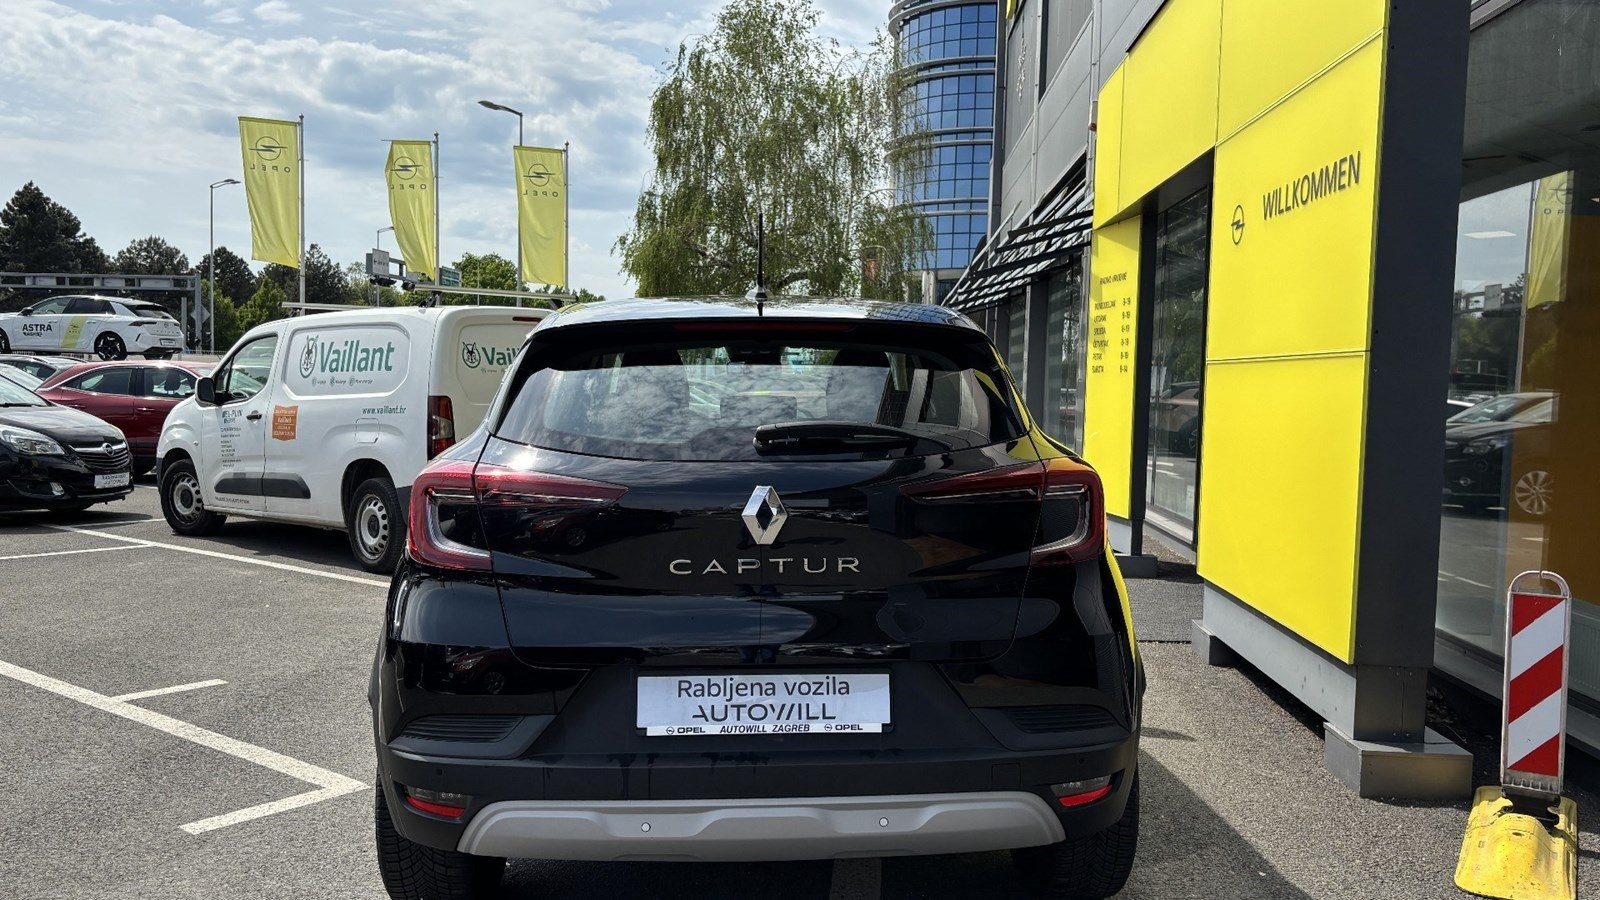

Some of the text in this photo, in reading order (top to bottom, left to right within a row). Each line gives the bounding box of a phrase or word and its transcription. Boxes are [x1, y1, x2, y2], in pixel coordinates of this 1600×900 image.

[1262, 150, 1361, 221] WILLKOMMEN
[22, 323, 53, 332] ASTRA
[320, 340, 395, 373] Vaillant
[481, 346, 520, 366] Vail
[362, 405, 407, 415] www.vaillant.hr
[669, 557, 861, 575] CAPTUR
[677, 675, 850, 702] Rabljena vozila
[692, 703, 837, 722] AUTOWILL
[719, 725, 767, 734] AUTOWILL
[772, 724, 810, 733] ZAGREB
[834, 723, 863, 731] OPEL
